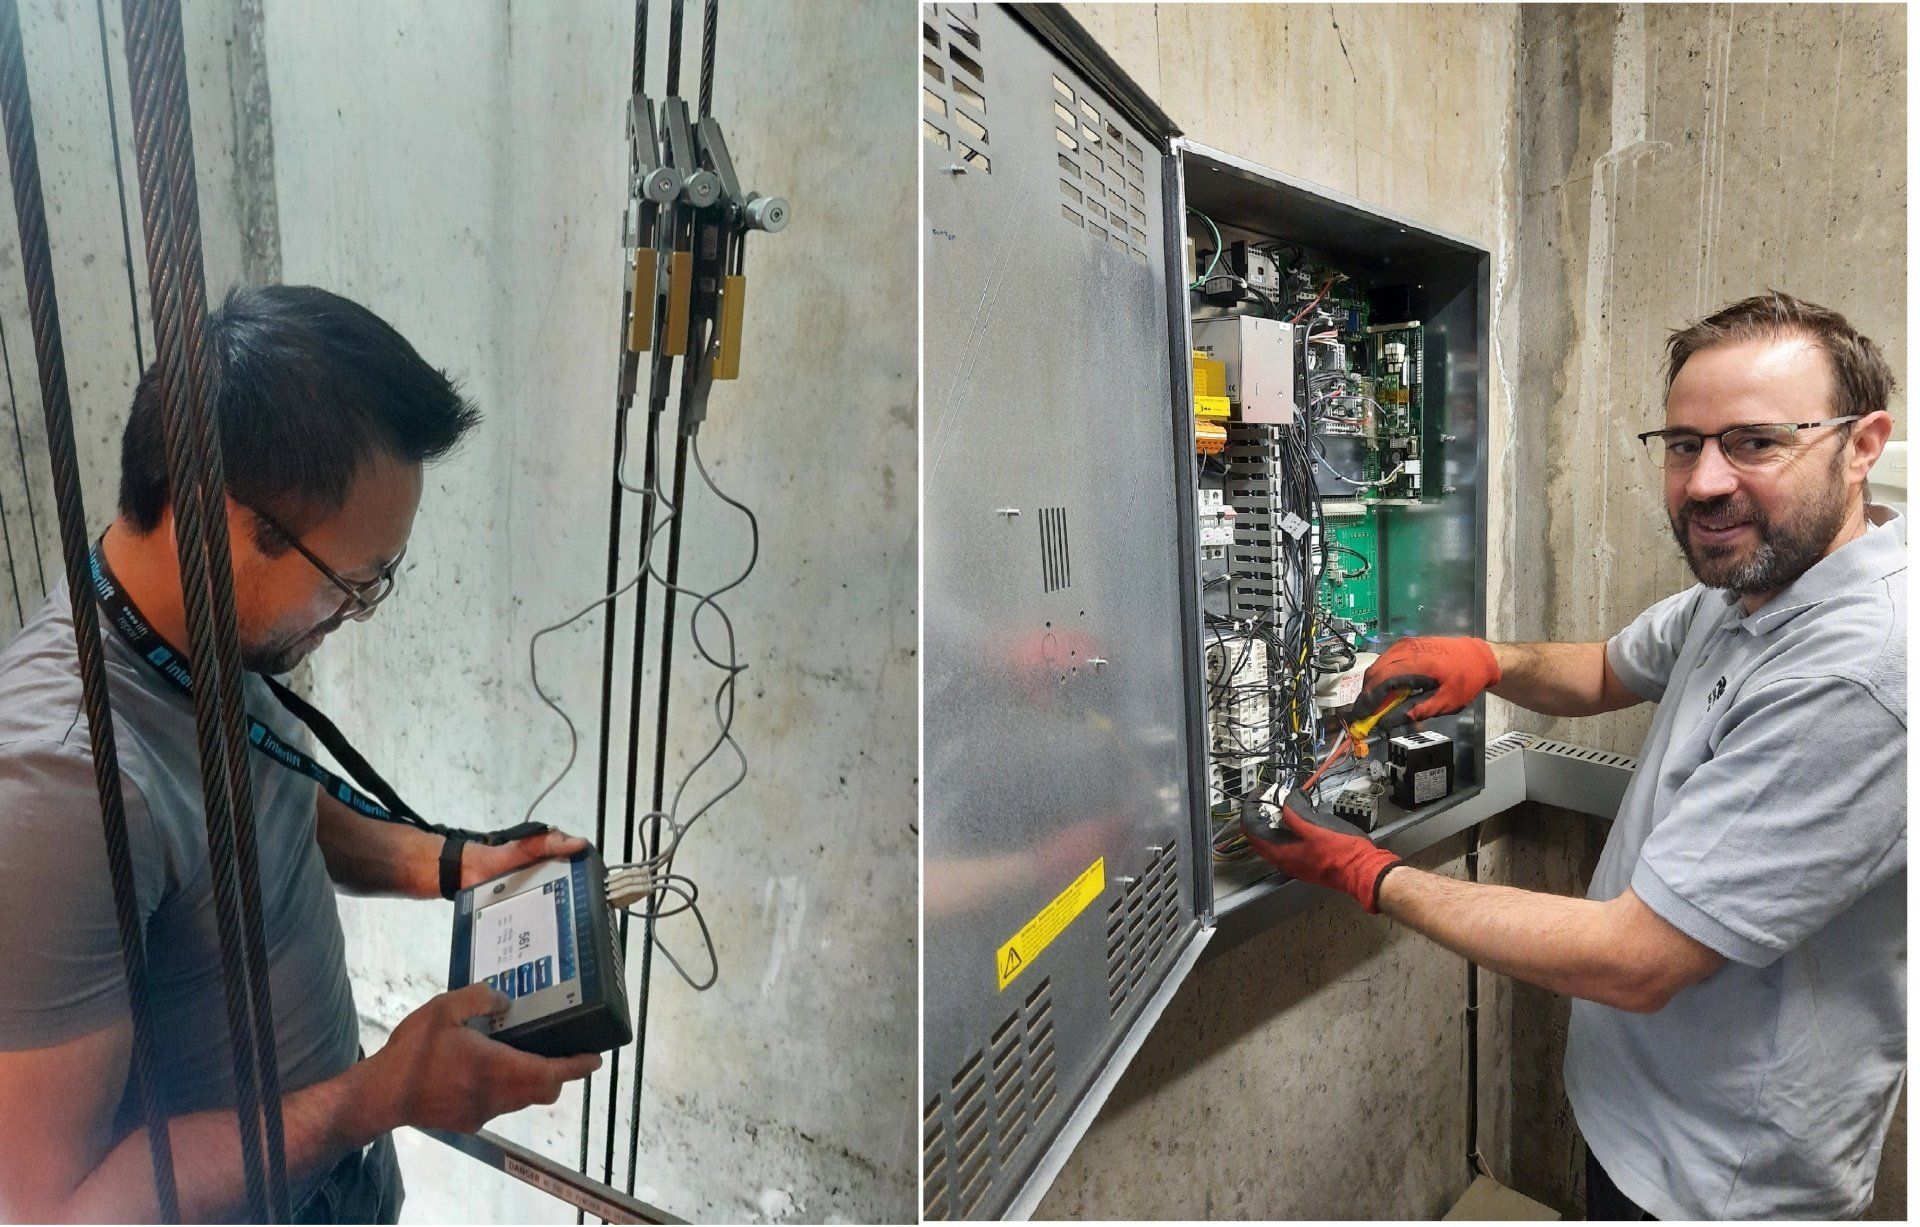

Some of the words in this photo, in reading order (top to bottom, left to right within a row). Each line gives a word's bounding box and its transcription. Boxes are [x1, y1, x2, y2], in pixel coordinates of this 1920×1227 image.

[165, 660, 193, 689] inter
[264, 735, 301, 768] interlift
[518, 931, 530, 951] 561
[507, 1159, 540, 1184] DANGER
